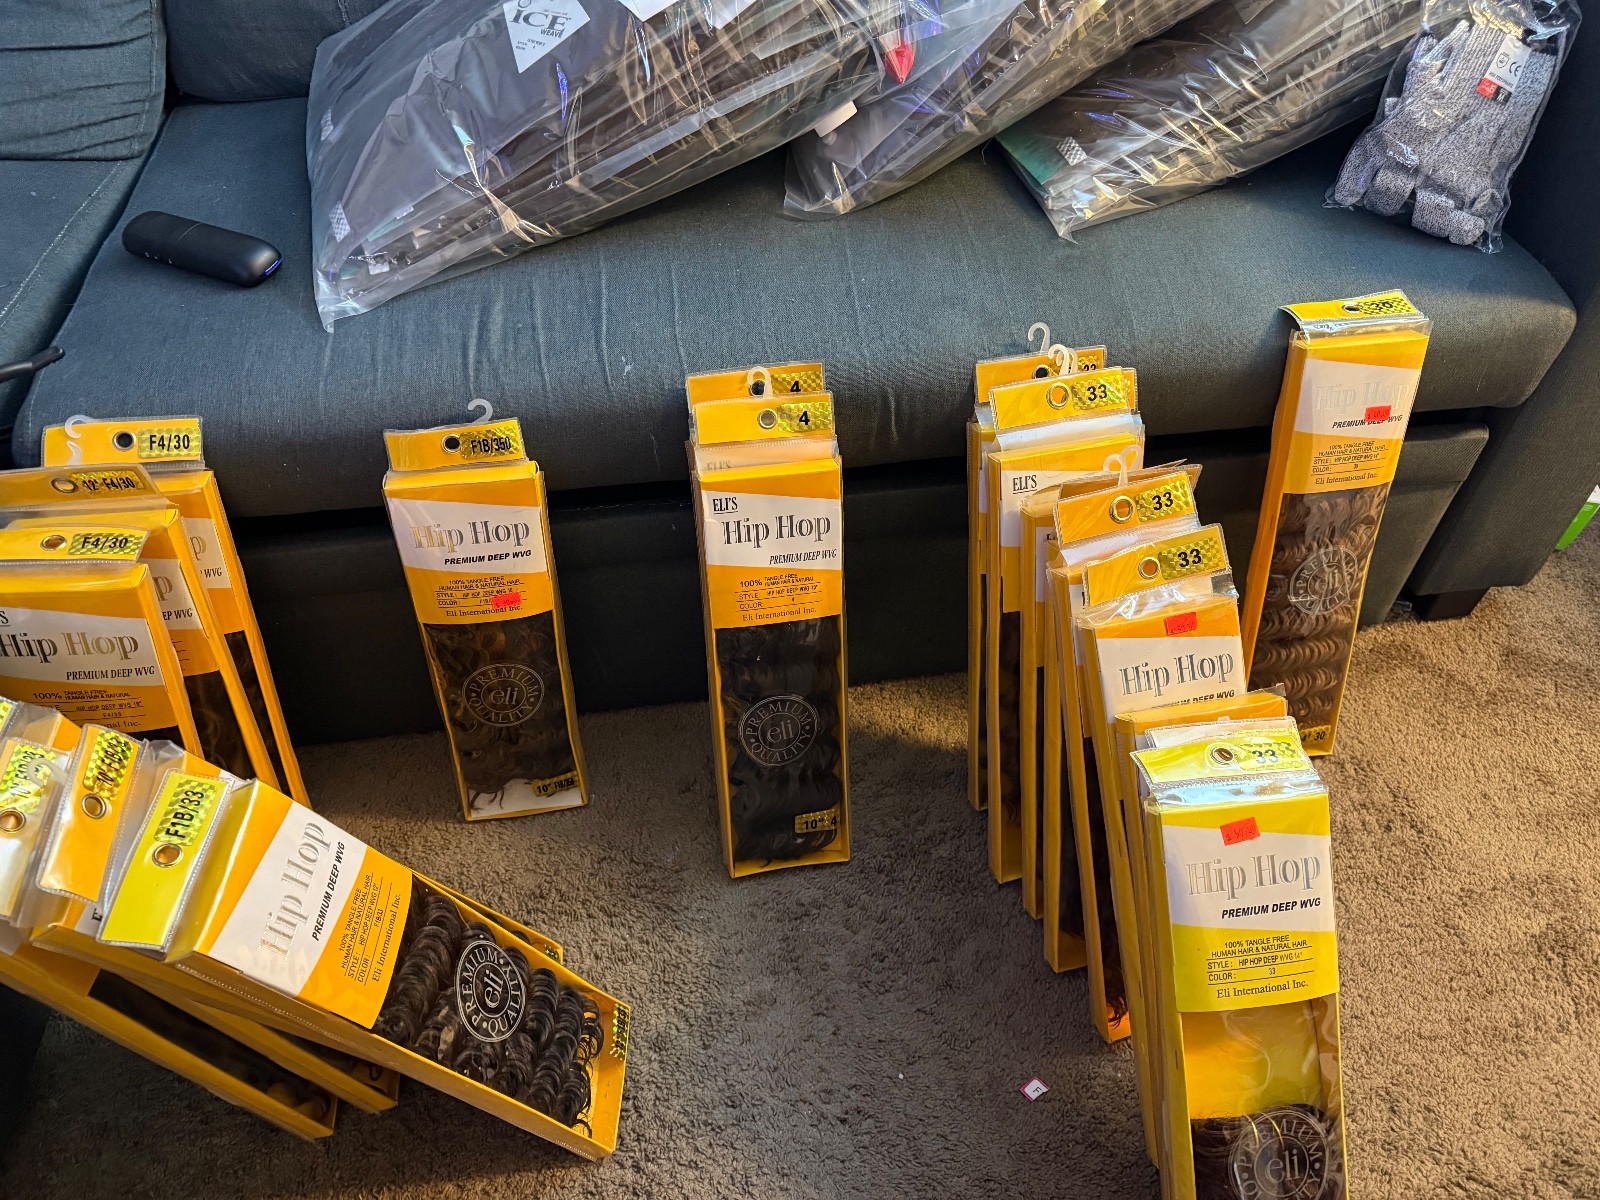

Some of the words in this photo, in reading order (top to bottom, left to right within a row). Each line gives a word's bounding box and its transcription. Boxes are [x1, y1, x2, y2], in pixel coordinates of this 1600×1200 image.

[509, 9, 572, 32] ICE
[790, 381, 801, 393] 4
[1087, 384, 1107, 401] 33
[799, 411, 810, 426] 4
[1332, 419, 1366, 428] PREMIUM
[149, 434, 190, 450] F4/30
[471, 436, 511, 454] F1B/350
[103, 477, 135, 491] F4/30
[1012, 474, 1037, 492] ELI'S
[712, 496, 738, 512] ELI'S
[1152, 491, 1174, 511] 33
[410, 523, 464, 553] Hip
[468, 520, 530, 546] Hop
[721, 517, 770, 548] Hip
[775, 515, 831, 543] Hop
[81, 536, 128, 549] F4/30
[444, 554, 485, 565] PREMIUM
[487, 552, 510, 562] DEEP
[512, 549, 532, 559] WVG
[769, 553, 801, 565] PREMIUM
[803, 551, 820, 561] DEEP
[821, 549, 837, 559] WVG
[1178, 549, 1202, 568] 33
[204, 567, 222, 578] WVG
[174, 608, 193, 619] WVG
[460, 607, 506, 616] International
[756, 608, 801, 620] International
[0, 632, 58, 663] Hip
[62, 632, 139, 660] Hop
[66, 669, 109, 681] PREMIUM
[111, 668, 133, 679] DEEP
[134, 666, 155, 676] WVG
[469, 667, 539, 697] PREMIUM
[1119, 661, 1170, 697] Hip
[1174, 653, 1234, 684] Hop
[33, 692, 62, 700] 100%
[489, 687, 518, 705] eli
[1216, 690, 1235, 699] WVG
[469, 697, 533, 723] QUALITY
[746, 702, 812, 736] PREMIUM
[767, 719, 794, 743] eli
[1314, 731, 1326, 741] 30
[751, 732, 811, 762] QUALITY
[1252, 749, 1278, 764] 33
[166, 790, 204, 839] F1B/33
[831, 815, 837, 826] 4
[281, 822, 332, 895] Hop
[1186, 858, 1247, 900] Hip
[1252, 854, 1321, 891] Hop
[312, 894, 335, 941] PREMIUM
[327, 866, 340, 893] DEEP
[335, 841, 345, 865] WVG
[1221, 905, 1269, 919] PREMIUM
[1272, 901, 1297, 913] DEEP
[1300, 898, 1321, 909] WVG
[258, 893, 310, 961] Hip
[339, 933, 349, 952] 100%
[345, 905, 357, 931] TANGLE
[353, 888, 361, 905] FREE
[341, 944, 353, 969] HUMAN
[349, 927, 358, 944] HAIR
[355, 891, 368, 920] NATURAL
[363, 874, 371, 891] HAIR
[372, 968, 382, 982] Eli
[377, 909, 398, 967] International
[391, 894, 401, 909] Inc.
[1225, 941, 1243, 949] 100%
[1245, 938, 1271, 946] TANGLE
[1273, 935, 1289, 943] FREE
[1211, 950, 1236, 958] HUMAN
[1238, 947, 1254, 955] HAIR
[1262, 943, 1291, 952] NATURAL
[1250, 957, 1262, 965] HOP
[1264, 956, 1278, 964] DEEP
[461, 947, 499, 1027] PREMIUM
[484, 969, 504, 1008] eli
[1217, 988, 1230, 998] Eli
[1233, 981, 1290, 996] International
[1293, 980, 1308, 988] Inc.
[488, 965, 521, 1038] QUALITY
[1265, 1149, 1300, 1184] eli
